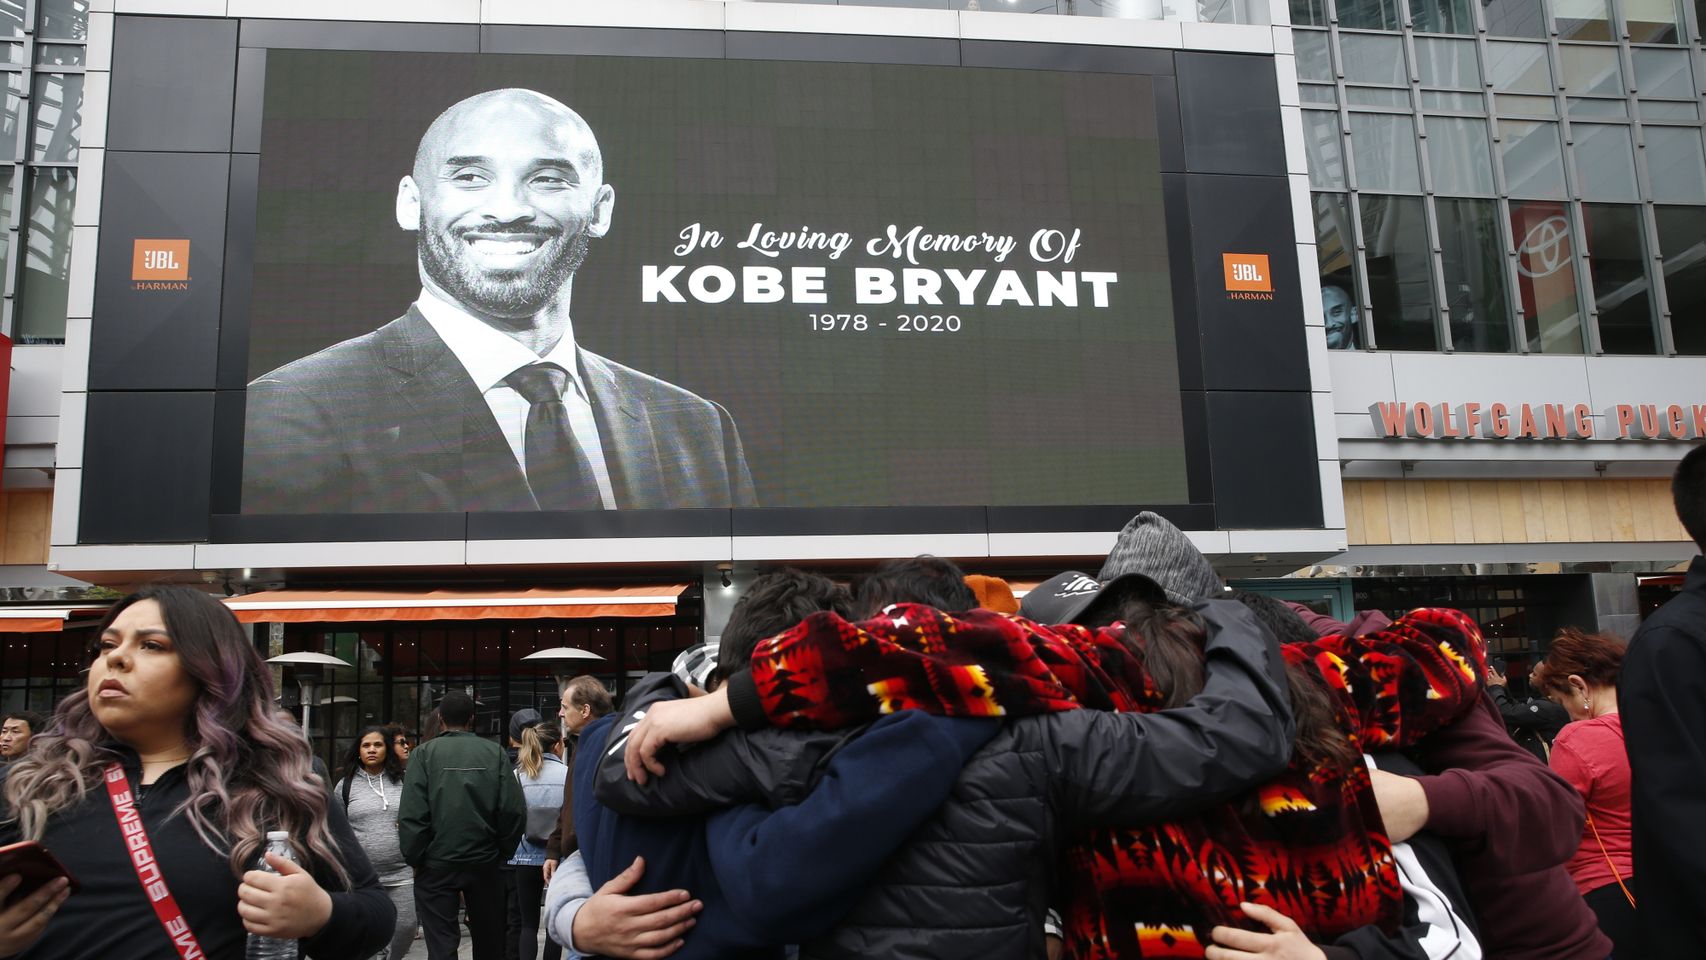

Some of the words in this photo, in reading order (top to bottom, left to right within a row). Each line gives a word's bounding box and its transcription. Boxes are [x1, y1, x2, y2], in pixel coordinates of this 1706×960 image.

[674, 222, 724, 256] In
[737, 222, 852, 260] Loving
[866, 224, 1016, 265] Memory
[1029, 228, 1081, 263] Of
[144, 250, 179, 269] JBL
[1232, 263, 1263, 281] JBL
[136, 282, 188, 290] HARMAN
[642, 264, 828, 304] KOBE
[855, 267, 1118, 308] BRYANT
[1230, 292, 1273, 300] HARMAN
[809, 314, 868, 331] 1978
[897, 315, 961, 332] 2020
[1374, 401, 1593, 438] WOLFGANG
[1615, 402, 1706, 439] PUCK
[113, 790, 170, 902] SUPREME
